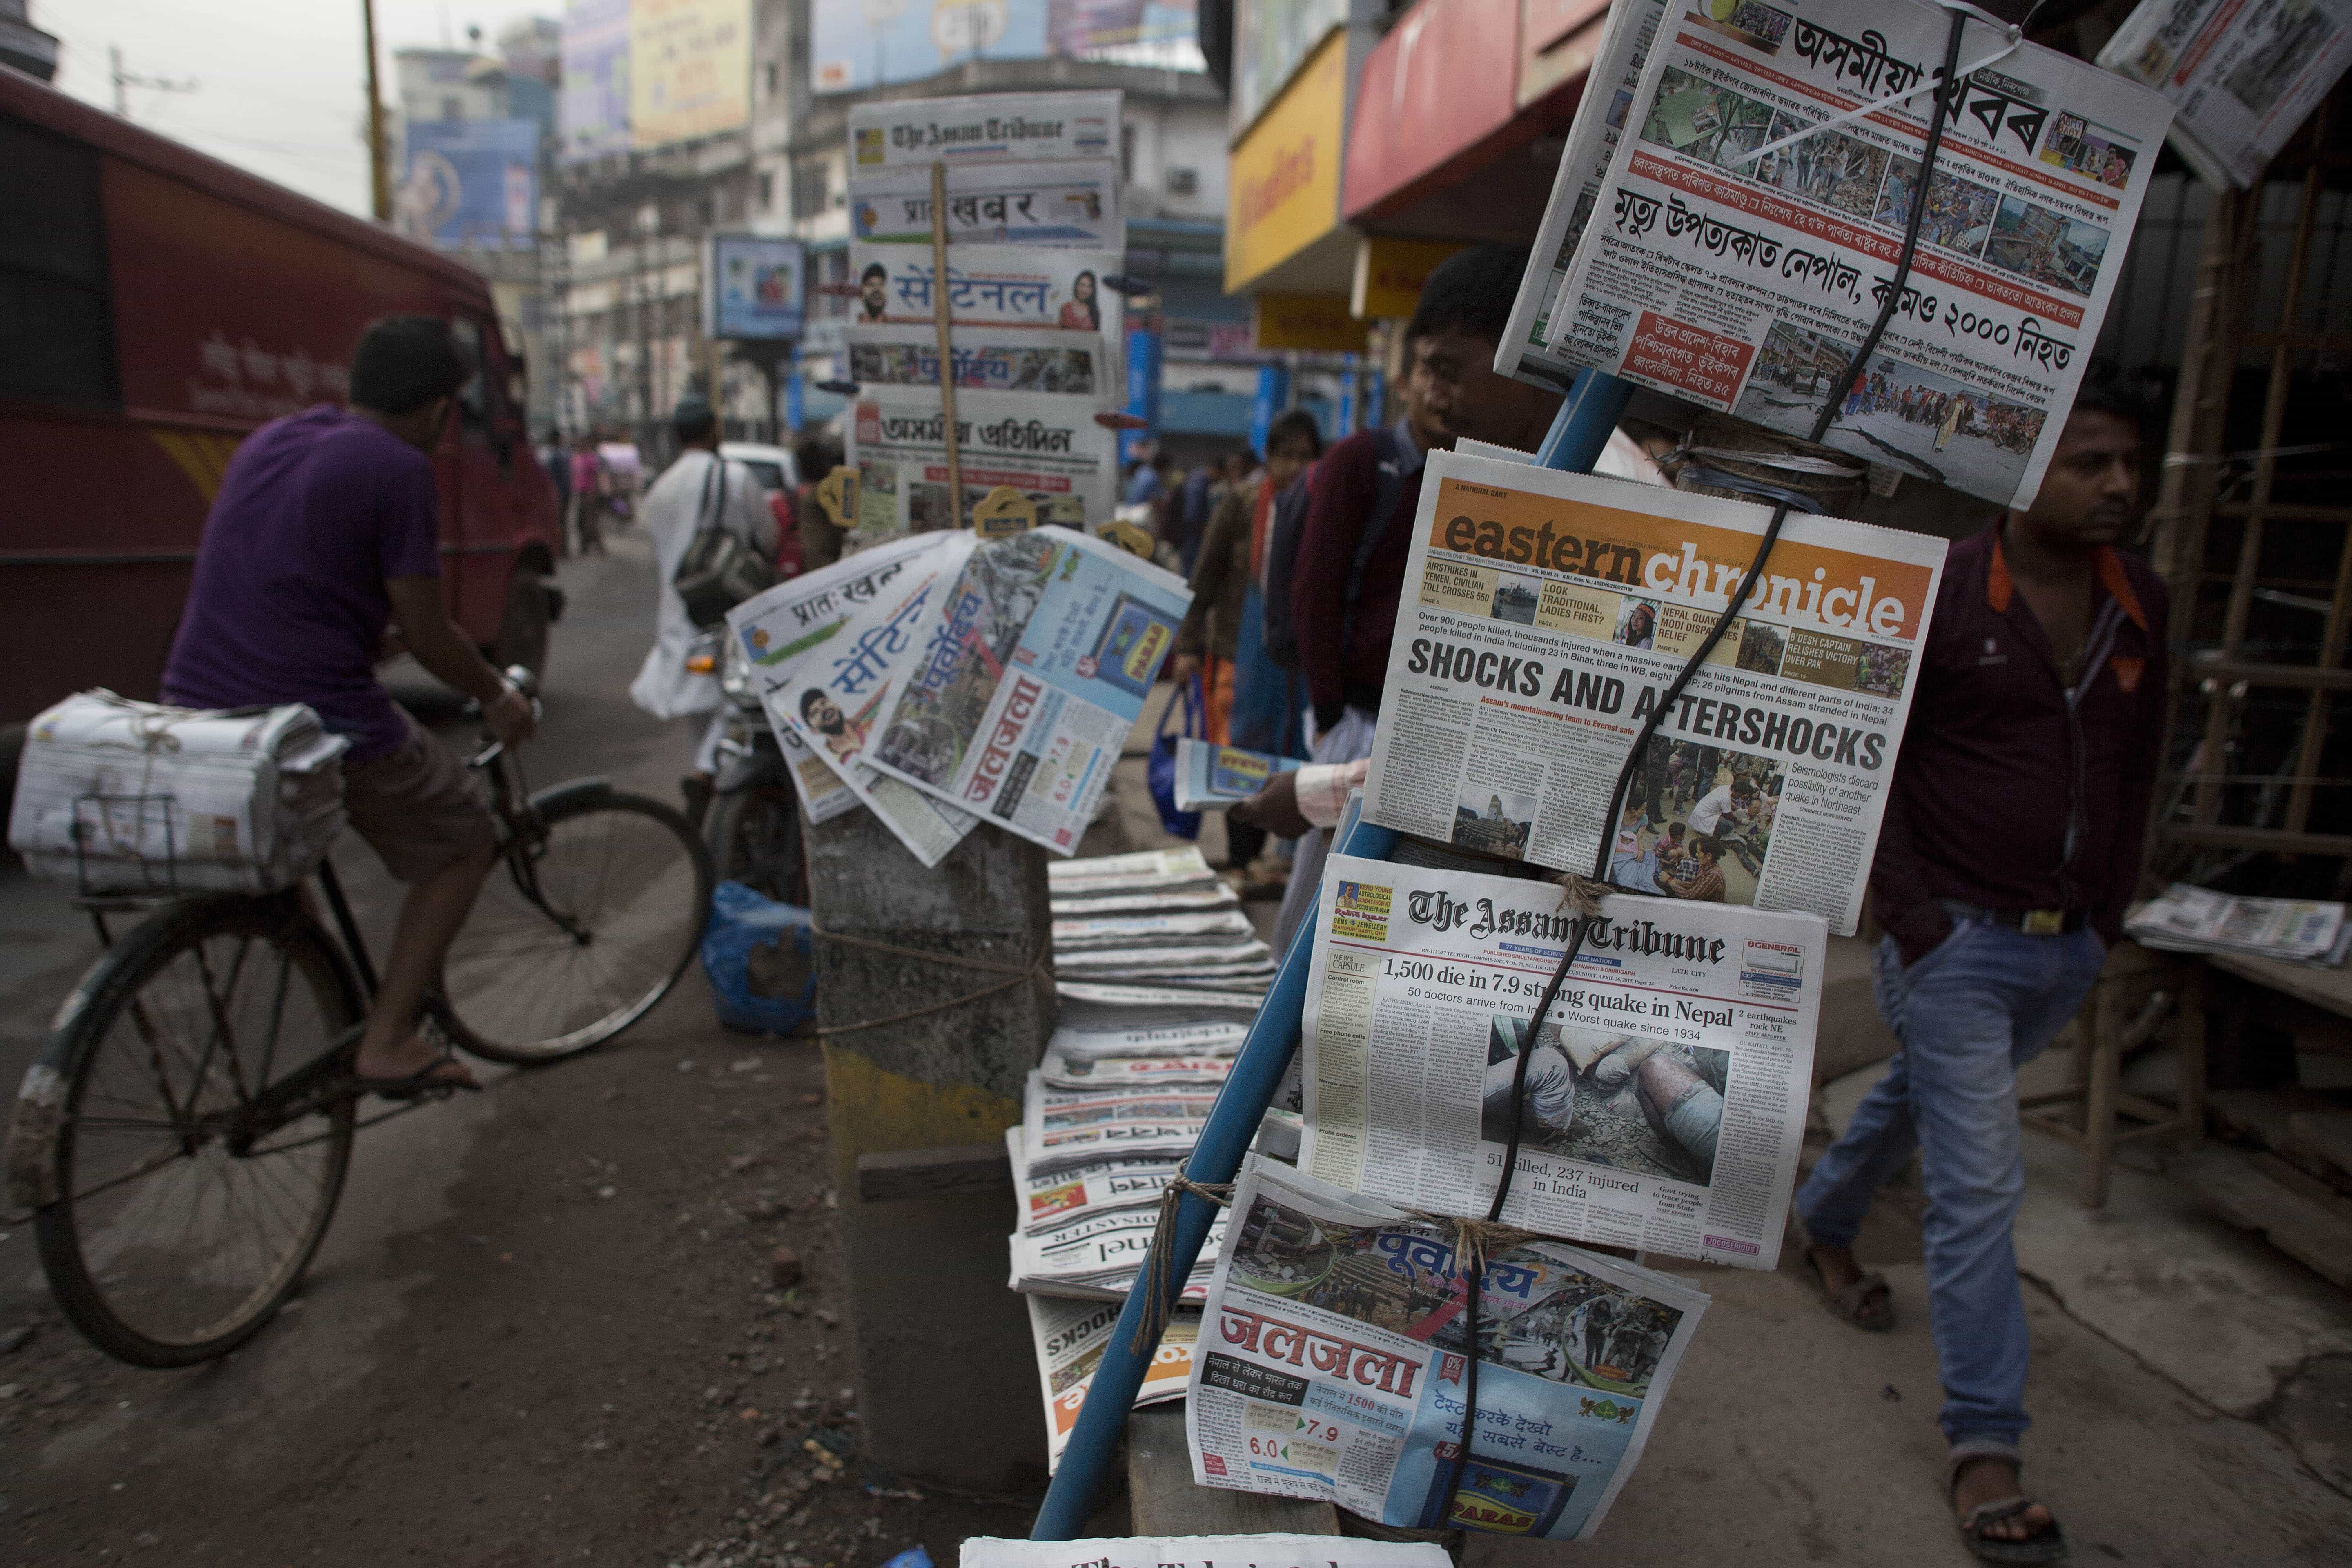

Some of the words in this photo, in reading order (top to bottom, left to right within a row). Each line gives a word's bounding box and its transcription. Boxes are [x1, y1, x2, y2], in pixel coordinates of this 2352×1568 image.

[1944, 303, 2009, 345] ২০০০
[2014, 317, 2075, 372] নিহত
[1461, 485, 1489, 495] NATIONAL
[1490, 490, 1507, 498] DAILY
[1425, 571, 1450, 585] YEMEN,
[1454, 577, 1483, 590] CIVILIAN
[1426, 561, 1468, 576] AIRSTRIKES
[1470, 569, 1477, 578] IN
[1446, 516, 1640, 585] eastern
[1642, 542, 1903, 635] chronicle
[1423, 581, 1439, 592] TOLL
[1442, 586, 1474, 599] CROSSES
[1476, 592, 1489, 601] 550
[1544, 584, 1568, 595] LOOK
[1539, 604, 1570, 617] LADIES
[1573, 611, 1604, 624] FIRST?
[1543, 594, 1602, 614] TRADITIONAL,
[1662, 606, 1691, 621] NEPAL
[1658, 628, 1687, 641] RELIEF
[1660, 617, 1685, 631] MODI
[1686, 622, 1739, 642] DISPAHES
[1787, 643, 1824, 658] RELISHES
[1826, 650, 1858, 664] VICTORY
[1820, 638, 1851, 652] CAPTAIN
[1419, 611, 1438, 621] Over
[1440, 616, 1455, 625] 900
[1457, 621, 1485, 631] people
[1488, 625, 1511, 637] killed,
[1515, 630, 1558, 646] thousands
[1561, 639, 1590, 652] injured
[1593, 648, 1615, 658] when
[1625, 655, 1660, 667] massive
[1663, 663, 1711, 677] earthake
[1714, 672, 1730, 682] hits
[1733, 675, 1758, 687] Nepal
[1760, 683, 1777, 691] and
[1780, 686, 1816, 699] different
[1818, 695, 1841, 704] parts
[1855, 700, 1880, 713] India;
[1882, 706, 1893, 715] 34
[1785, 654, 1805, 665] OVER
[1806, 658, 1822, 669] PAK
[1408, 639, 1543, 696] SHOCKS
[1550, 668, 1624, 713] AND
[1632, 686, 1884, 769] AFTERSHOCKS
[1481, 695, 1509, 707] Assam's
[1510, 704, 1563, 721] mountaineering
[1565, 714, 1582, 724] team
[1592, 720, 1618, 732] Everest
[963, 675, 1042, 803] जलजला
[1792, 762, 1846, 783] Seismologists
[1848, 775, 1879, 790] discard
[1787, 778, 1827, 795] possibility
[1829, 785, 1838, 795] of
[1838, 789, 1871, 802] another
[1785, 792, 1809, 804] quake
[1811, 795, 1819, 806] in
[1820, 797, 1861, 815] Northeast
[1409, 890, 1468, 931] The
[1470, 896, 1579, 944] Assam
[1585, 913, 1728, 967] Tribune
[1754, 941, 1802, 955] GENERAL
[1333, 960, 1364, 972] CAPSULE
[1671, 967, 1688, 976] LATE
[1690, 970, 1707, 978] CITY
[1385, 959, 1433, 980] 1,500
[1437, 966, 1464, 985] die
[1469, 969, 1486, 989] in
[1493, 974, 1519, 993] 7.9
[1588, 993, 1646, 1013] quake
[1651, 997, 1669, 1017] in
[1675, 1000, 1733, 1027] Nepal
[1408, 987, 1421, 997] 50
[1424, 990, 1462, 1003] doctors
[1466, 997, 1495, 1008] arrive
[1500, 1000, 1523, 1012] from
[1528, 1004, 1554, 1017] Ina
[1568, 1011, 1599, 1024] Worst
[1603, 1019, 1636, 1030] quake
[1641, 1023, 1669, 1035] since
[1675, 1028, 1700, 1040] 1934
[1747, 1013, 1796, 1026] earthquakes
[1770, 1024, 1783, 1032] NE
[1487, 1153, 1502, 1167] 51
[1557, 1166, 1584, 1181] 237
[1588, 1172, 1638, 1193] injured
[1533, 1177, 1545, 1191] in
[1552, 1180, 1586, 1198] India
[1708, 1238, 1756, 1253] JOCOSERIOUS
[1047, 1305, 1122, 1358] HOCKS
[1219, 1306, 1422, 1398] जलजला
[1445, 1355, 1463, 1371] 0%
[1209, 1356, 1231, 1369] नेपाल
[1232, 1360, 1241, 1372] से
[1243, 1364, 1263, 1379] लेकर
[1265, 1373, 1286, 1386] भारत
[1287, 1380, 1302, 1389] तक
[1210, 1371, 1231, 1385] दिखा
[1249, 1384, 1261, 1394] का
[1346, 1393, 1376, 1411] 1500
[1305, 1419, 1341, 1442] 7.9
[1247, 1435, 1281, 1459] 6.0
[1448, 1501, 1534, 1529] PARAS
